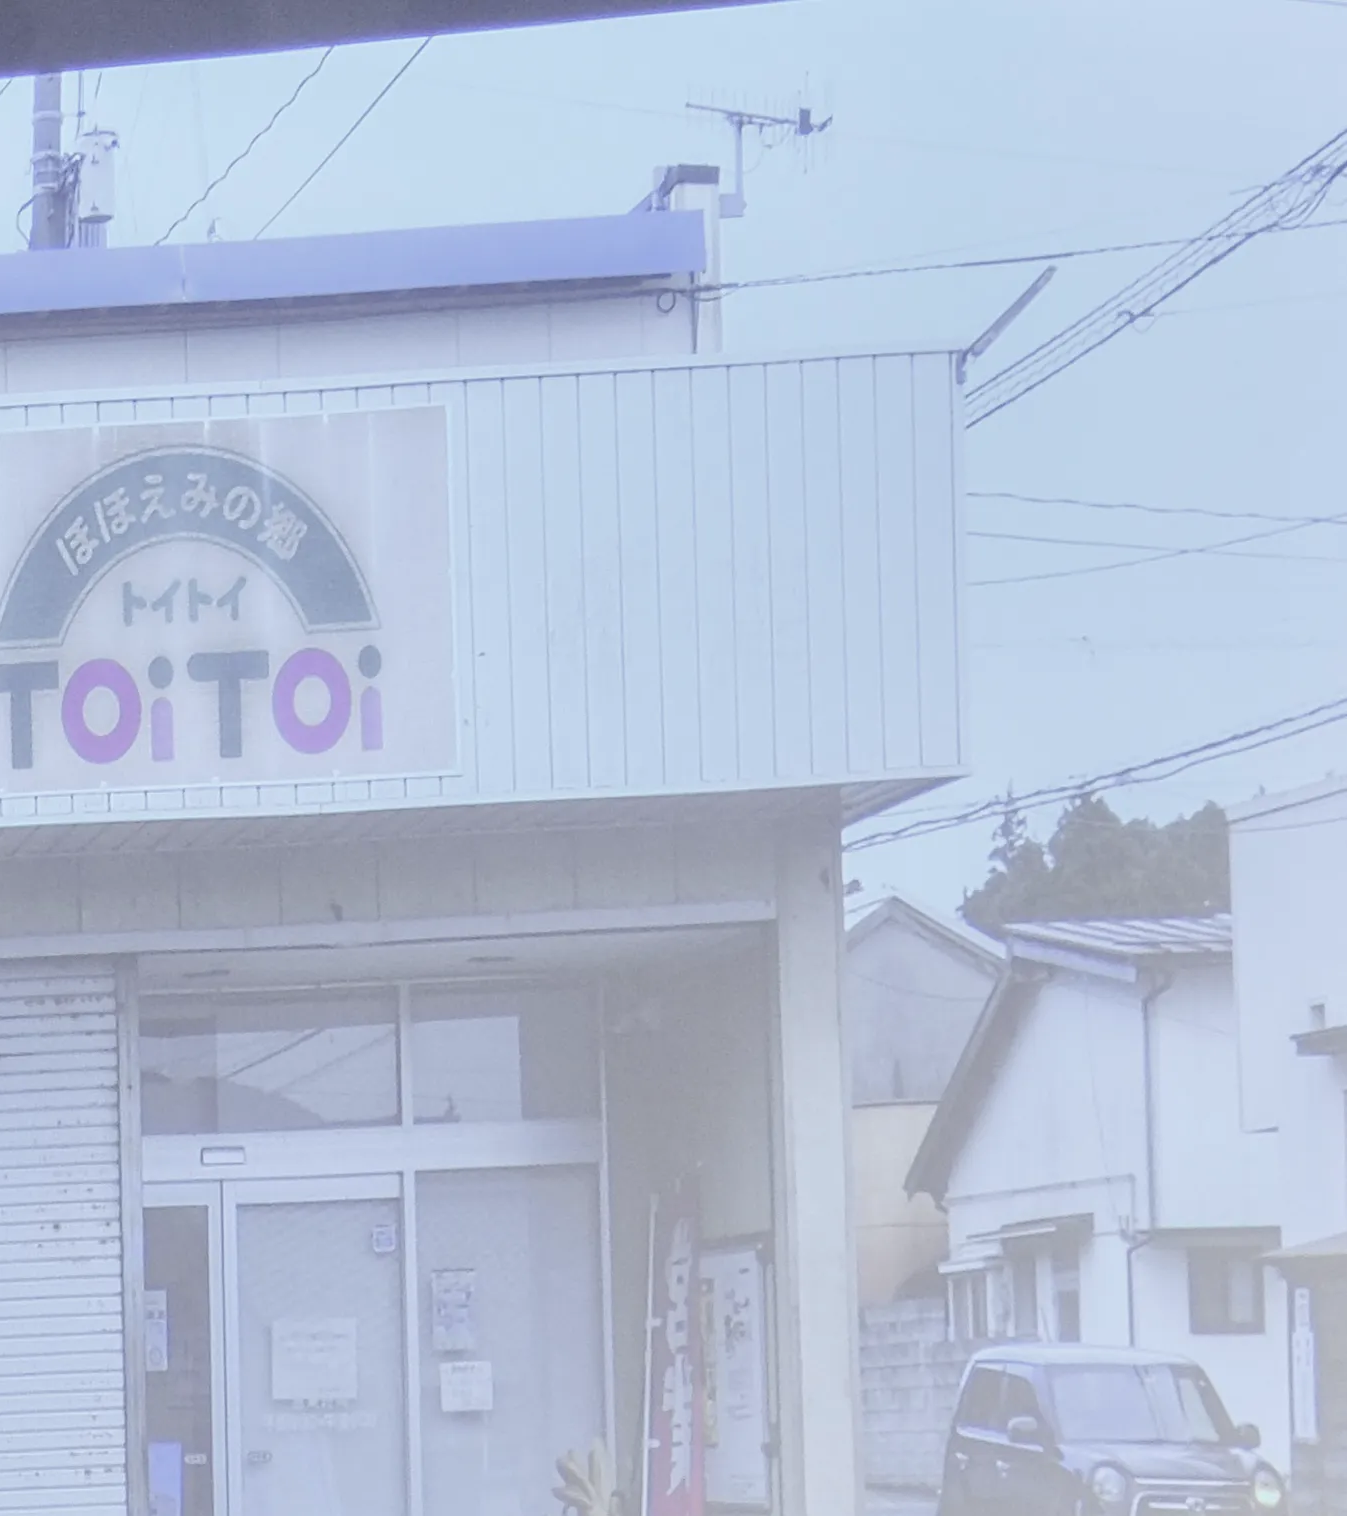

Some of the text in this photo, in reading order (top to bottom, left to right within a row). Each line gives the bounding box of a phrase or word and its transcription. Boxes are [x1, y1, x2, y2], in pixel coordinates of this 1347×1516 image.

[56, 474, 308, 576] ほほえみの郷
[122, 577, 248, 626] トイトイ
